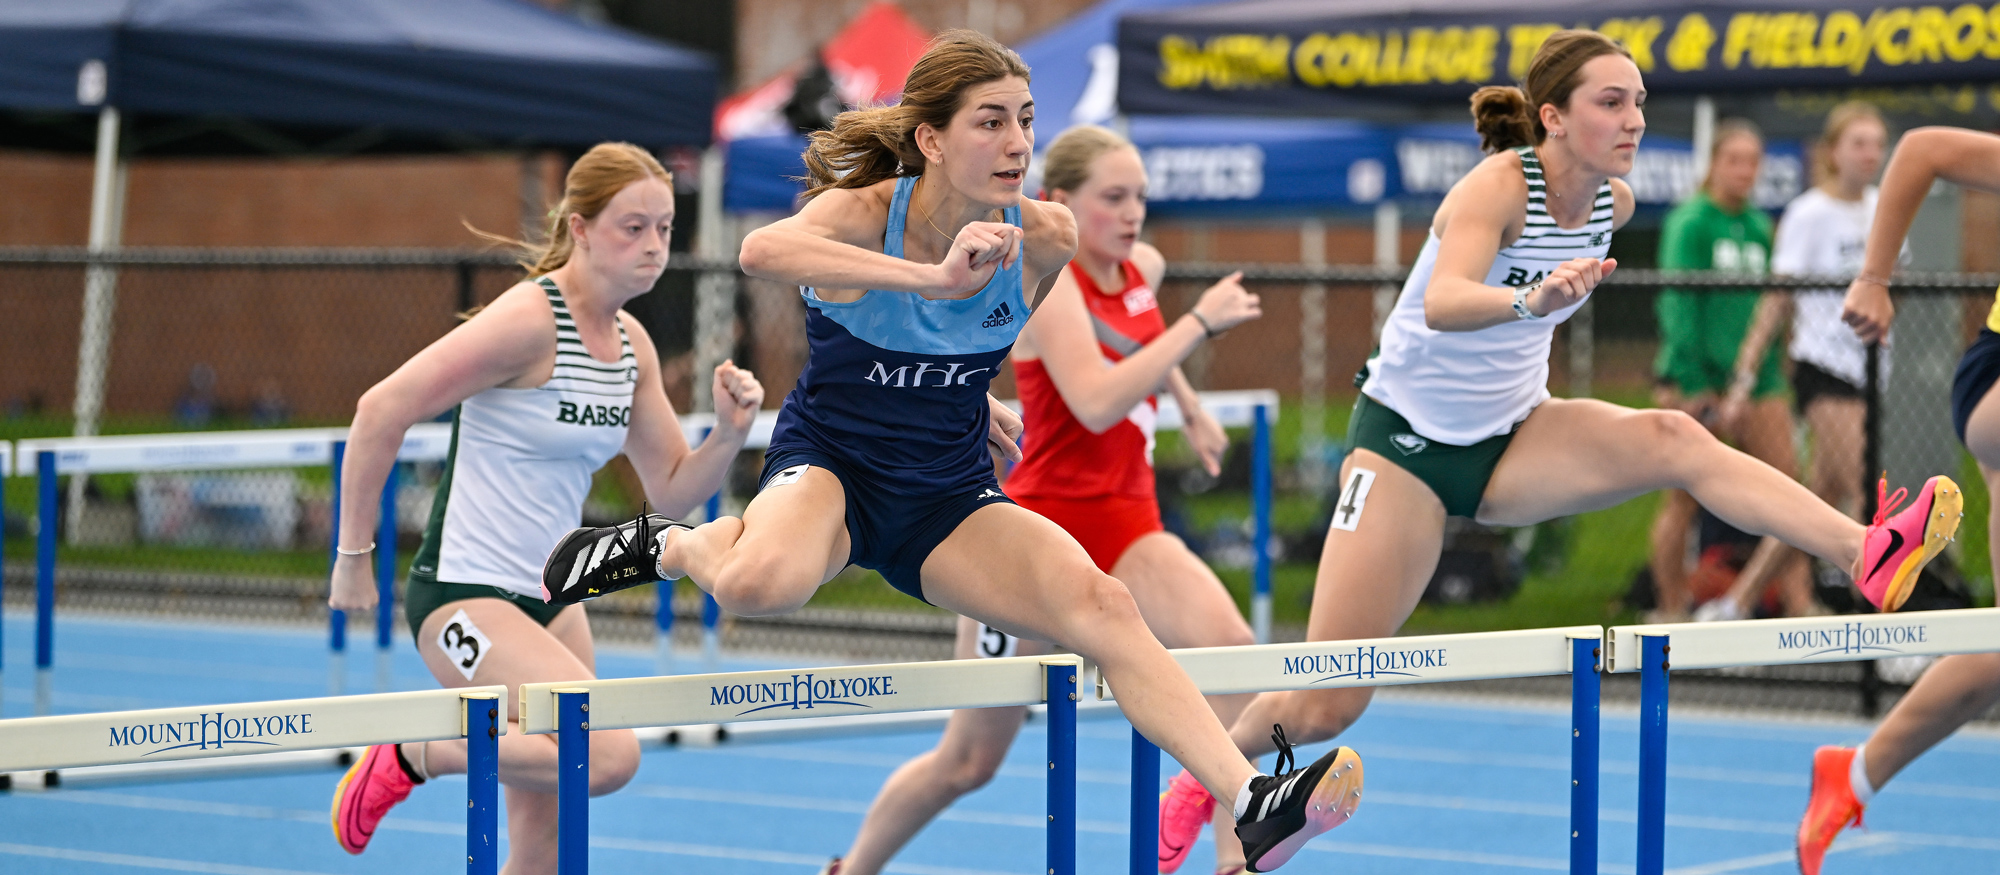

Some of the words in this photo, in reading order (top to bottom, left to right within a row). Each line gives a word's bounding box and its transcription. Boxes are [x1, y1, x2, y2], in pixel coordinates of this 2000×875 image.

[1294, 26, 1497, 87] COLLEGE
[1666, 12, 1717, 72] &
[982, 313, 1014, 329] adidas
[1340, 473, 1364, 525] 4
[444, 622, 480, 669] 3
[983, 625, 1007, 657] 5
[1778, 629, 1844, 650] MOUNT
[1844, 622, 1928, 654] HOLYOKE
[1283, 653, 1356, 675] MOUNT
[1356, 646, 1448, 680] HOLYOKE
[710, 682, 791, 706] MOUNT
[109, 721, 199, 747] MOUNT
[199, 712, 314, 750] HOLYOKE
